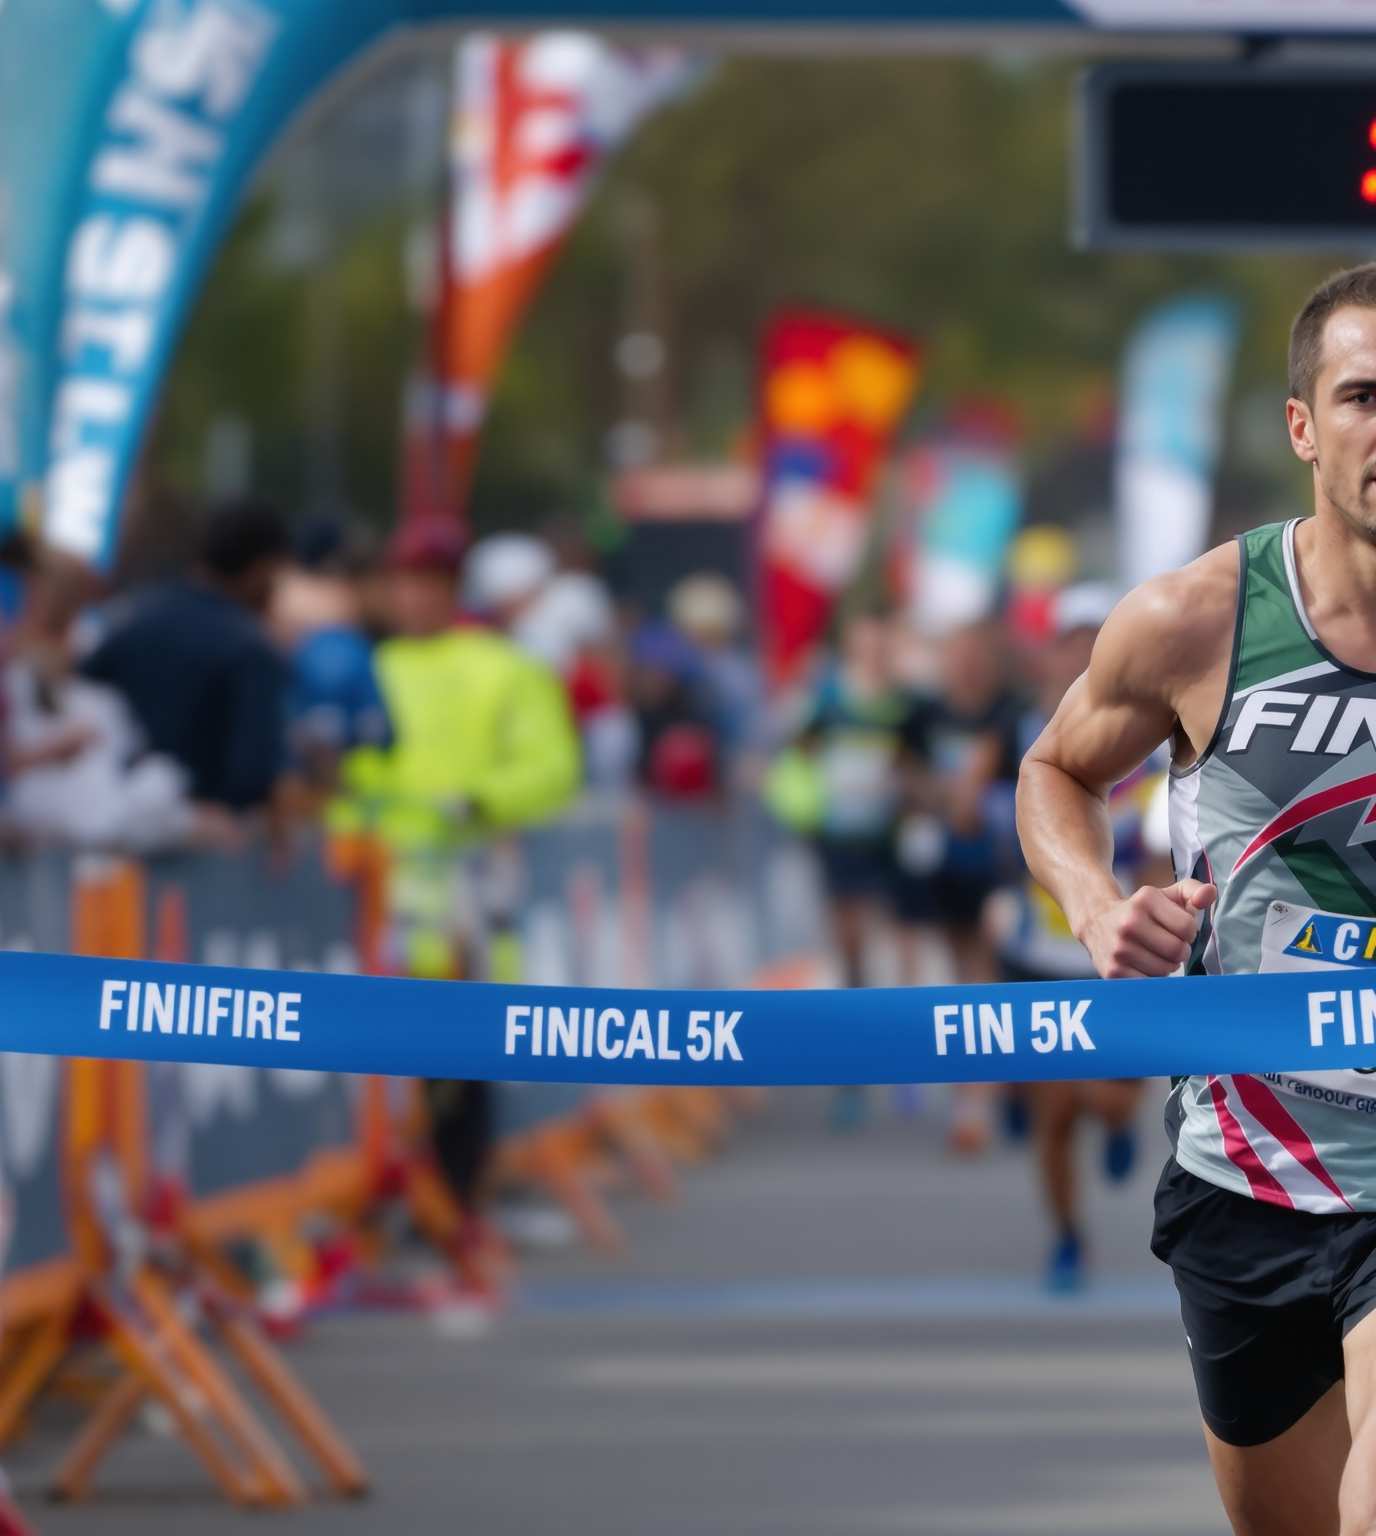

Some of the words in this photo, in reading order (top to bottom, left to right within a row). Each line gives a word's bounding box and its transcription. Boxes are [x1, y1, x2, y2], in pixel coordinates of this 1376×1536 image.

[1333, 922, 1360, 961] C
[100, 980, 301, 1041] FINIIFIRE
[505, 1005, 680, 1060] FINICAL
[686, 1011, 743, 1061] 5K
[934, 1003, 1015, 1055] FIN
[1031, 1000, 1096, 1053] 5K
